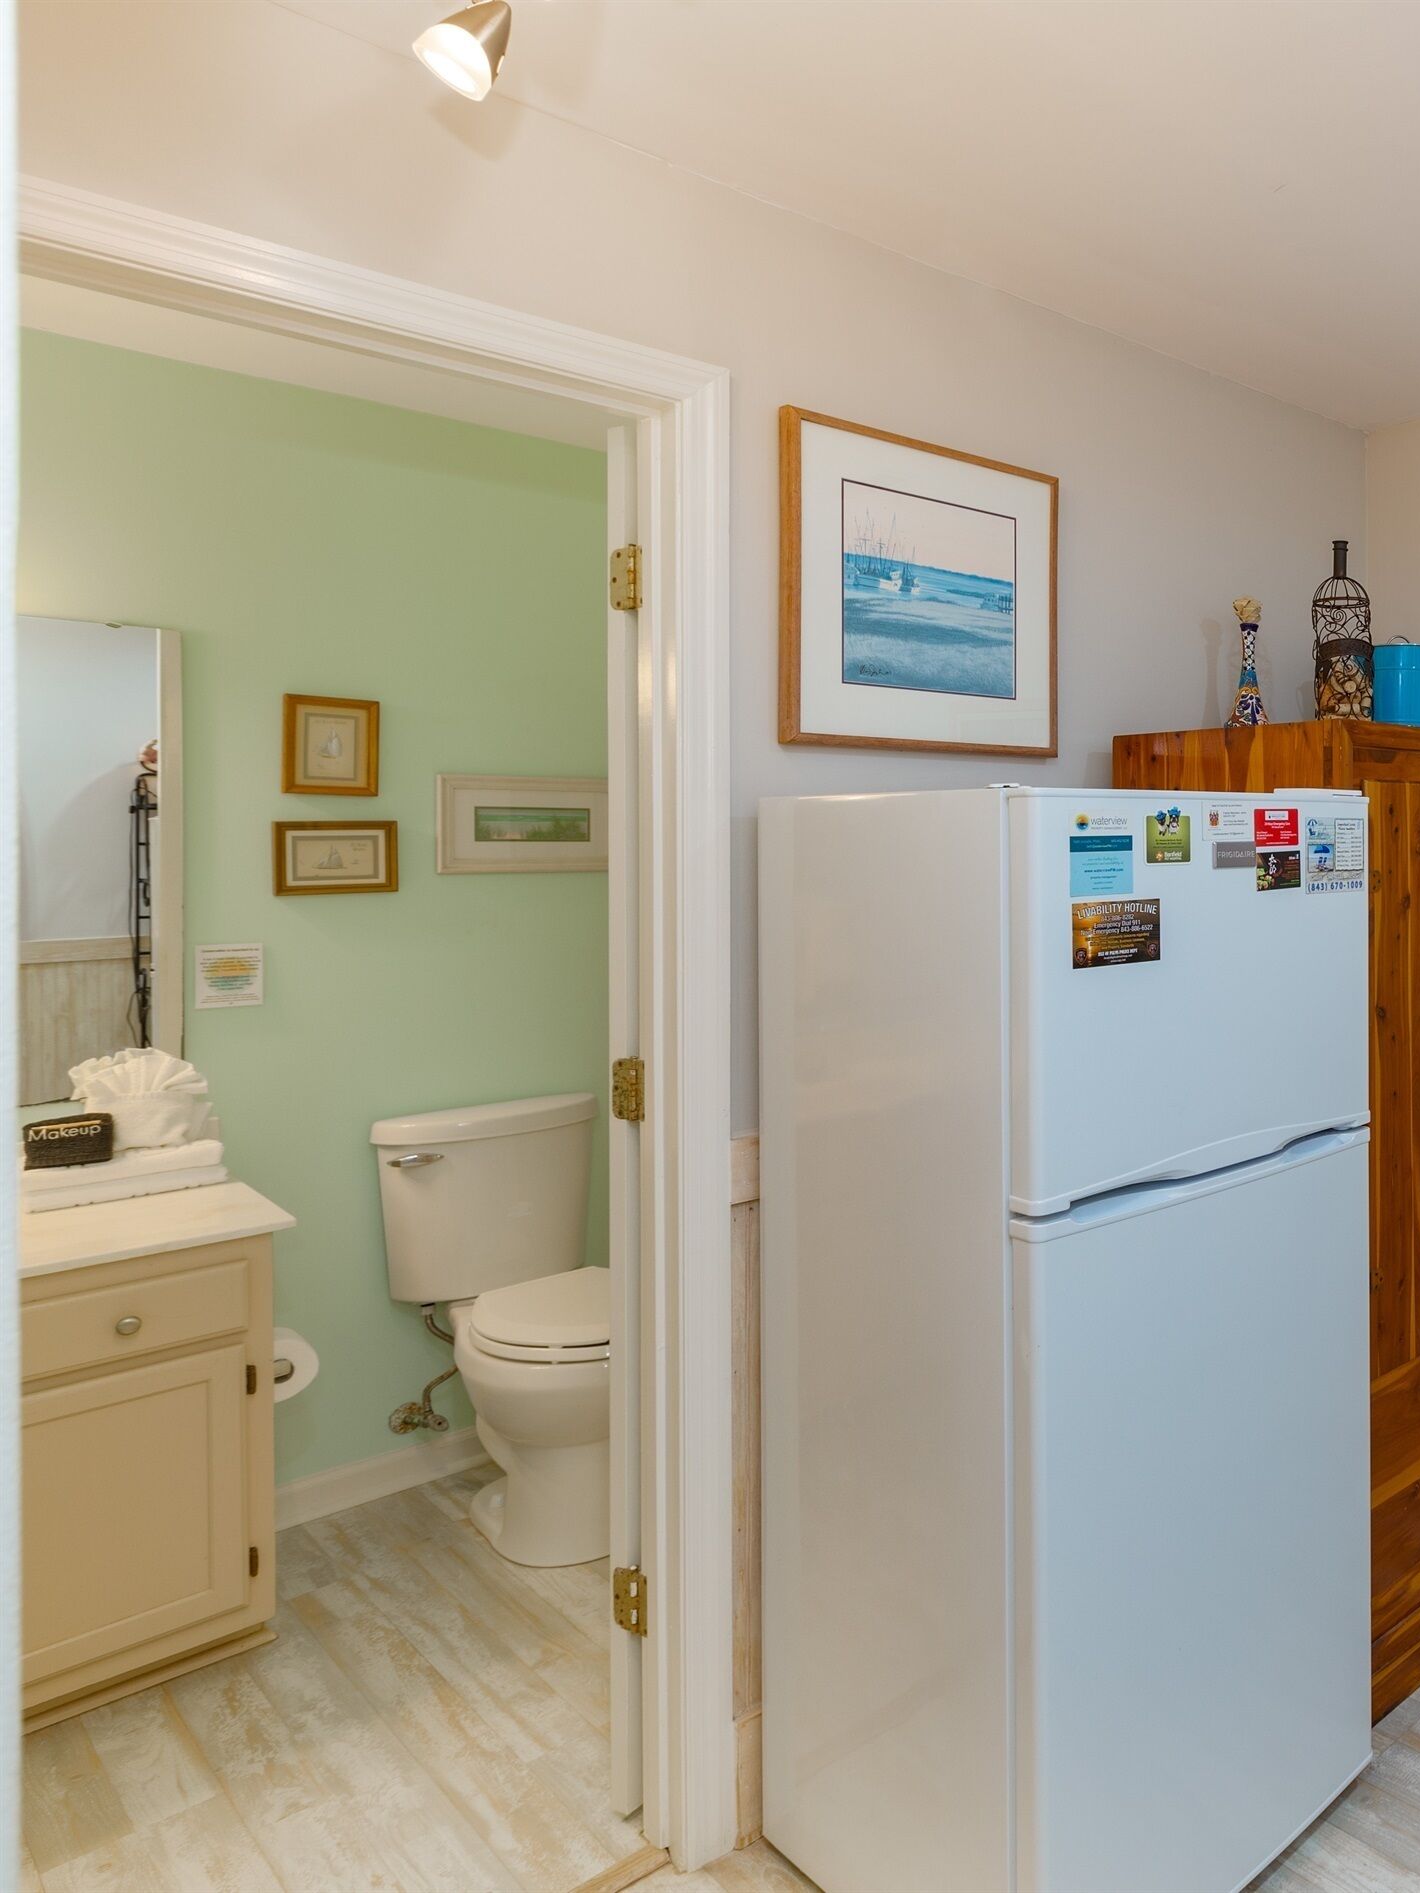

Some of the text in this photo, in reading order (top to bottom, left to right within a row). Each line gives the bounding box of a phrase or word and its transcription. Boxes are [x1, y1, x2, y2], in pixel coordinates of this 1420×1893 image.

[1091, 816, 1128, 825] waterview
[1217, 850, 1255, 858] FRIGIDAIRE
[1308, 882, 1328, 893] (843)
[1330, 880, 1363, 890] 670-1009
[1077, 903, 1158, 920] LIVABILITY HOTLINE
[1093, 922, 1121, 930] Emergency
[28, 1124, 101, 1142] Makeup
